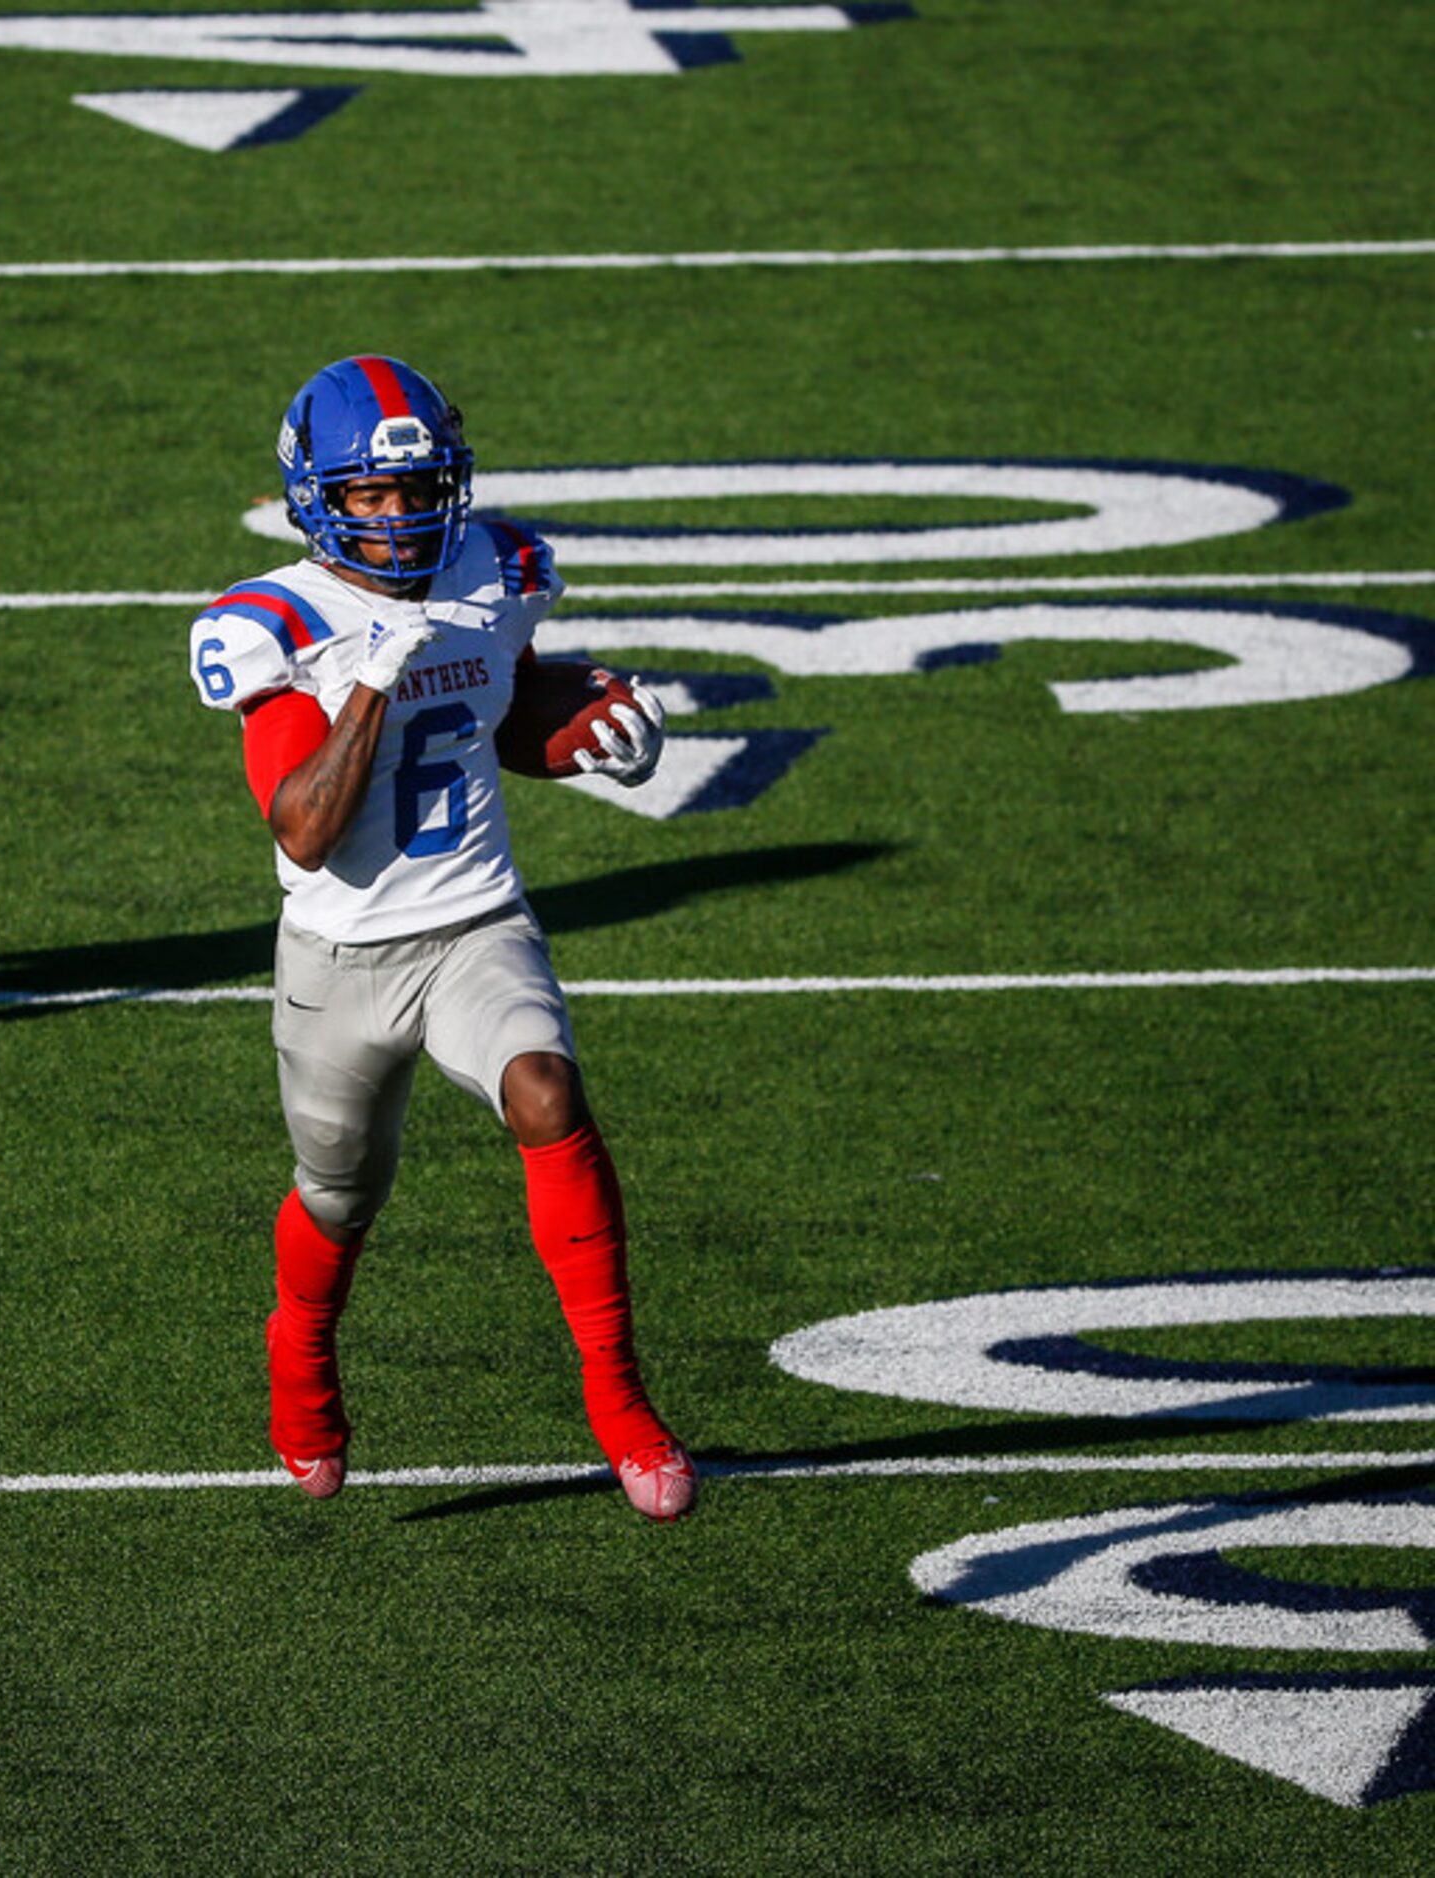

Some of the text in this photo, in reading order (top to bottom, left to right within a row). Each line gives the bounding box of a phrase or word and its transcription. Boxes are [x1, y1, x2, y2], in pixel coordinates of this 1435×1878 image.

[197, 637, 235, 702] 6
[396, 656, 490, 702] ANTHERS
[394, 701, 477, 859] 6
